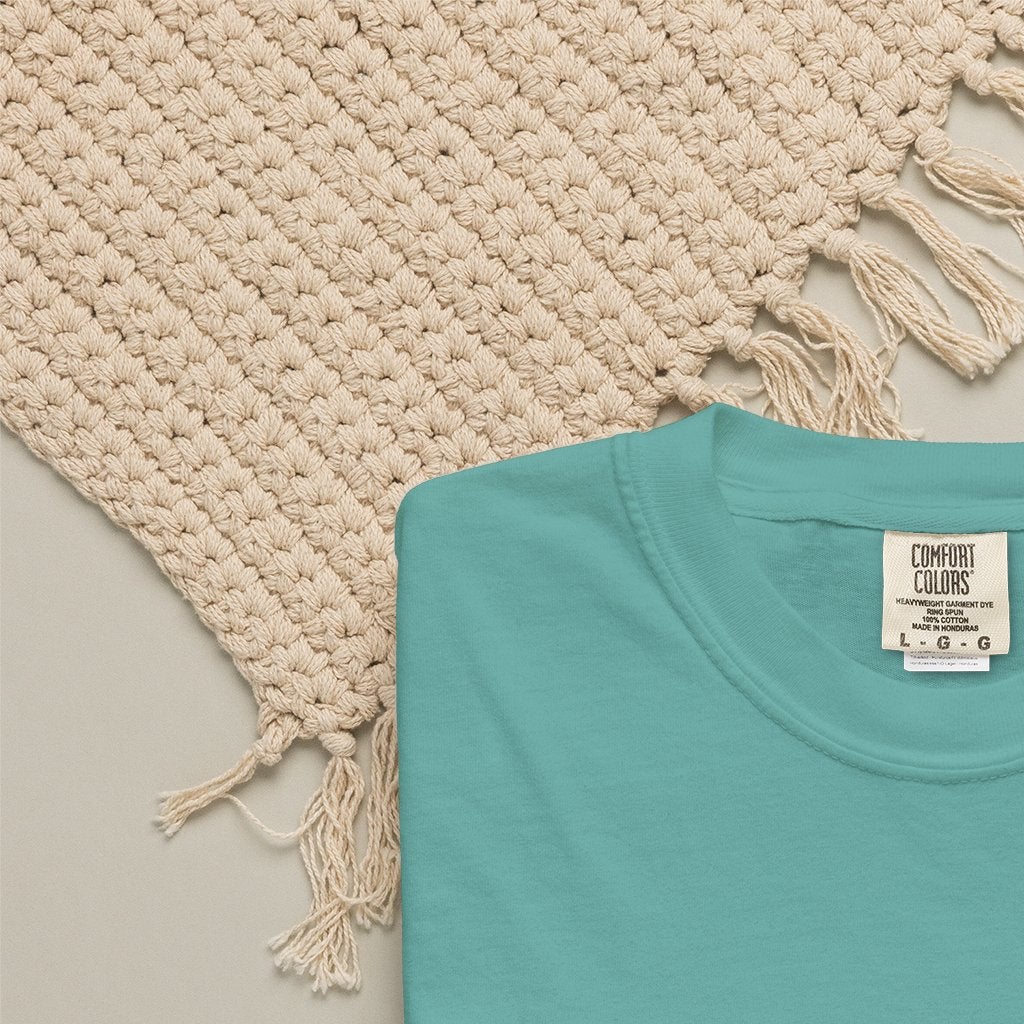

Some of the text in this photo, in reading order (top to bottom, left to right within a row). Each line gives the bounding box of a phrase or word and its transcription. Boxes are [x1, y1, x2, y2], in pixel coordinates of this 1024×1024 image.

[912, 543, 976, 569] COMFORT
[895, 597, 994, 609] HEAVYWEIGHT GARMENT DYE
[926, 608, 963, 616] RING SPUN
[922, 616, 969, 624] 100% COTTON
[912, 623, 979, 632] MADE IN HONDURAS
[899, 632, 910, 648] L
[936, 635, 950, 650] G
[977, 635, 991, 651] G
